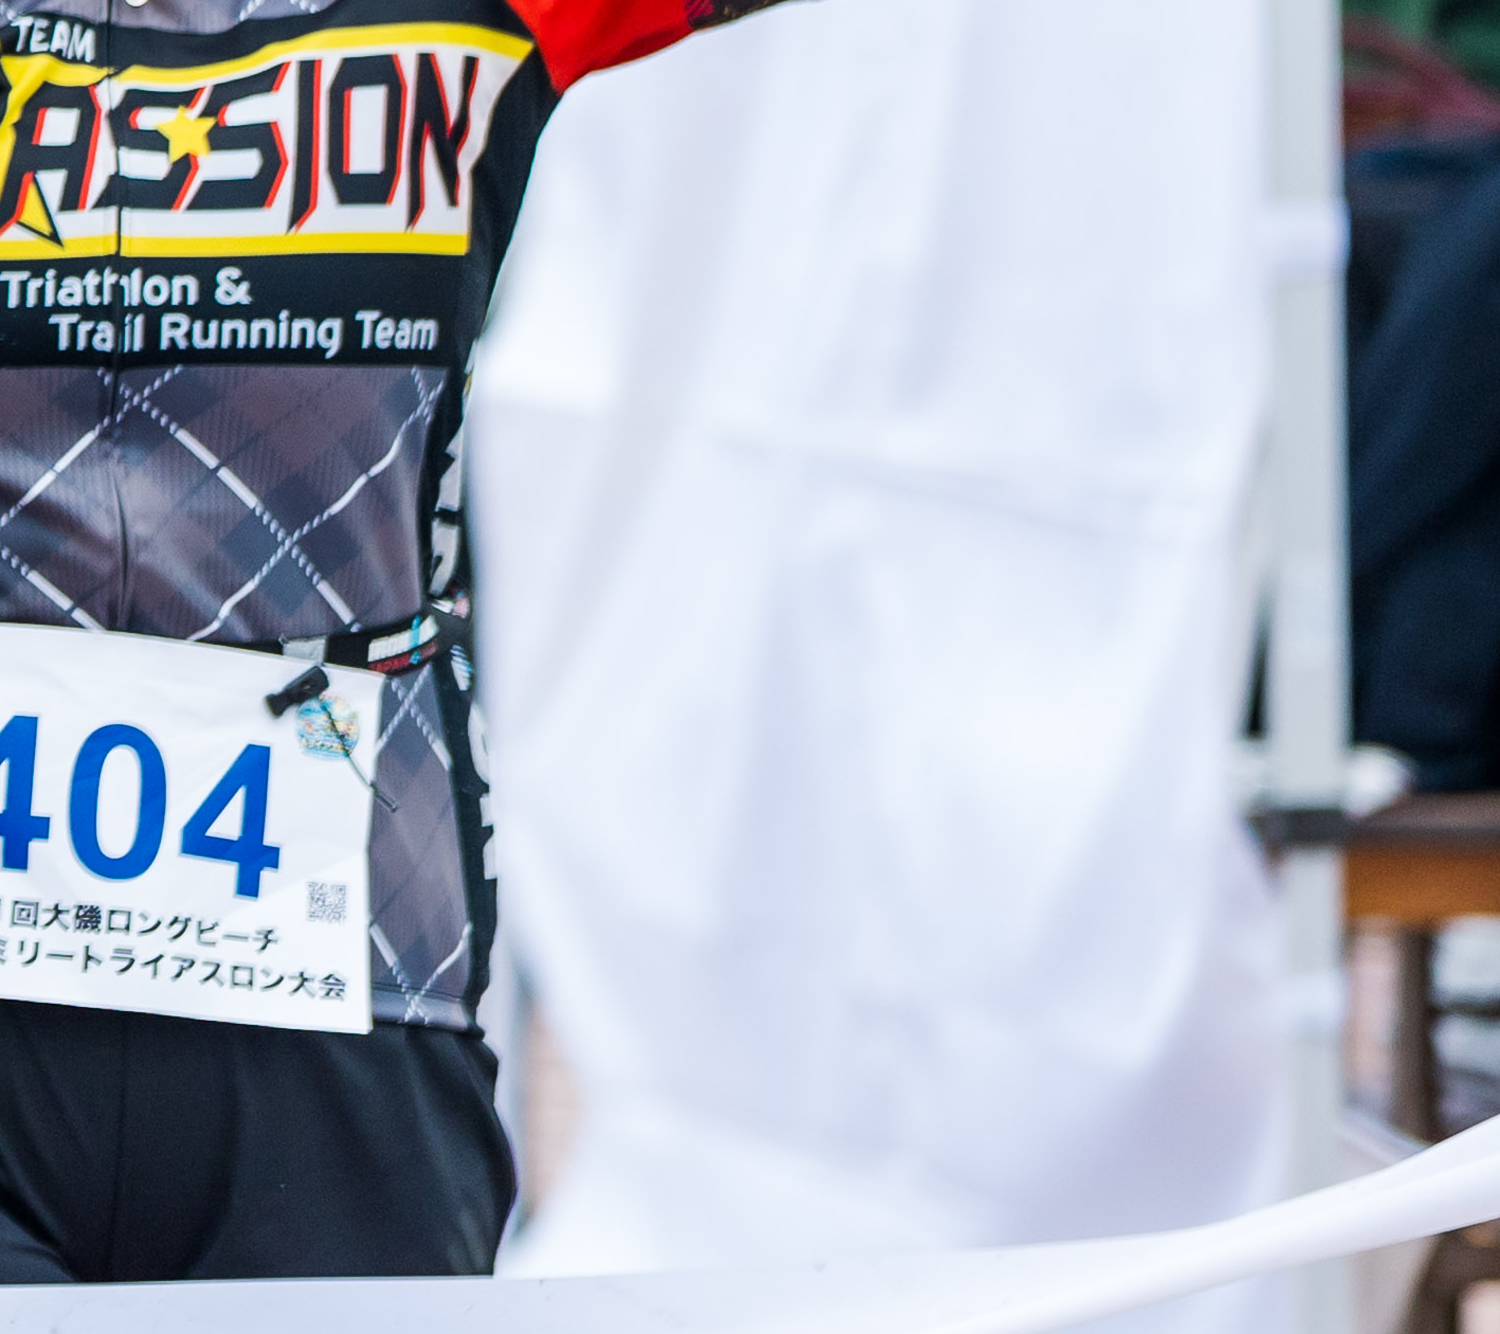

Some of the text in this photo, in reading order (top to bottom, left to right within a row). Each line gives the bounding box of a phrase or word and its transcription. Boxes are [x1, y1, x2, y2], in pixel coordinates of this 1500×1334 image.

[11, 15, 96, 63] TEAM
[214, 265, 252, 307] &
[48, 308, 439, 360] Trail Running Team
